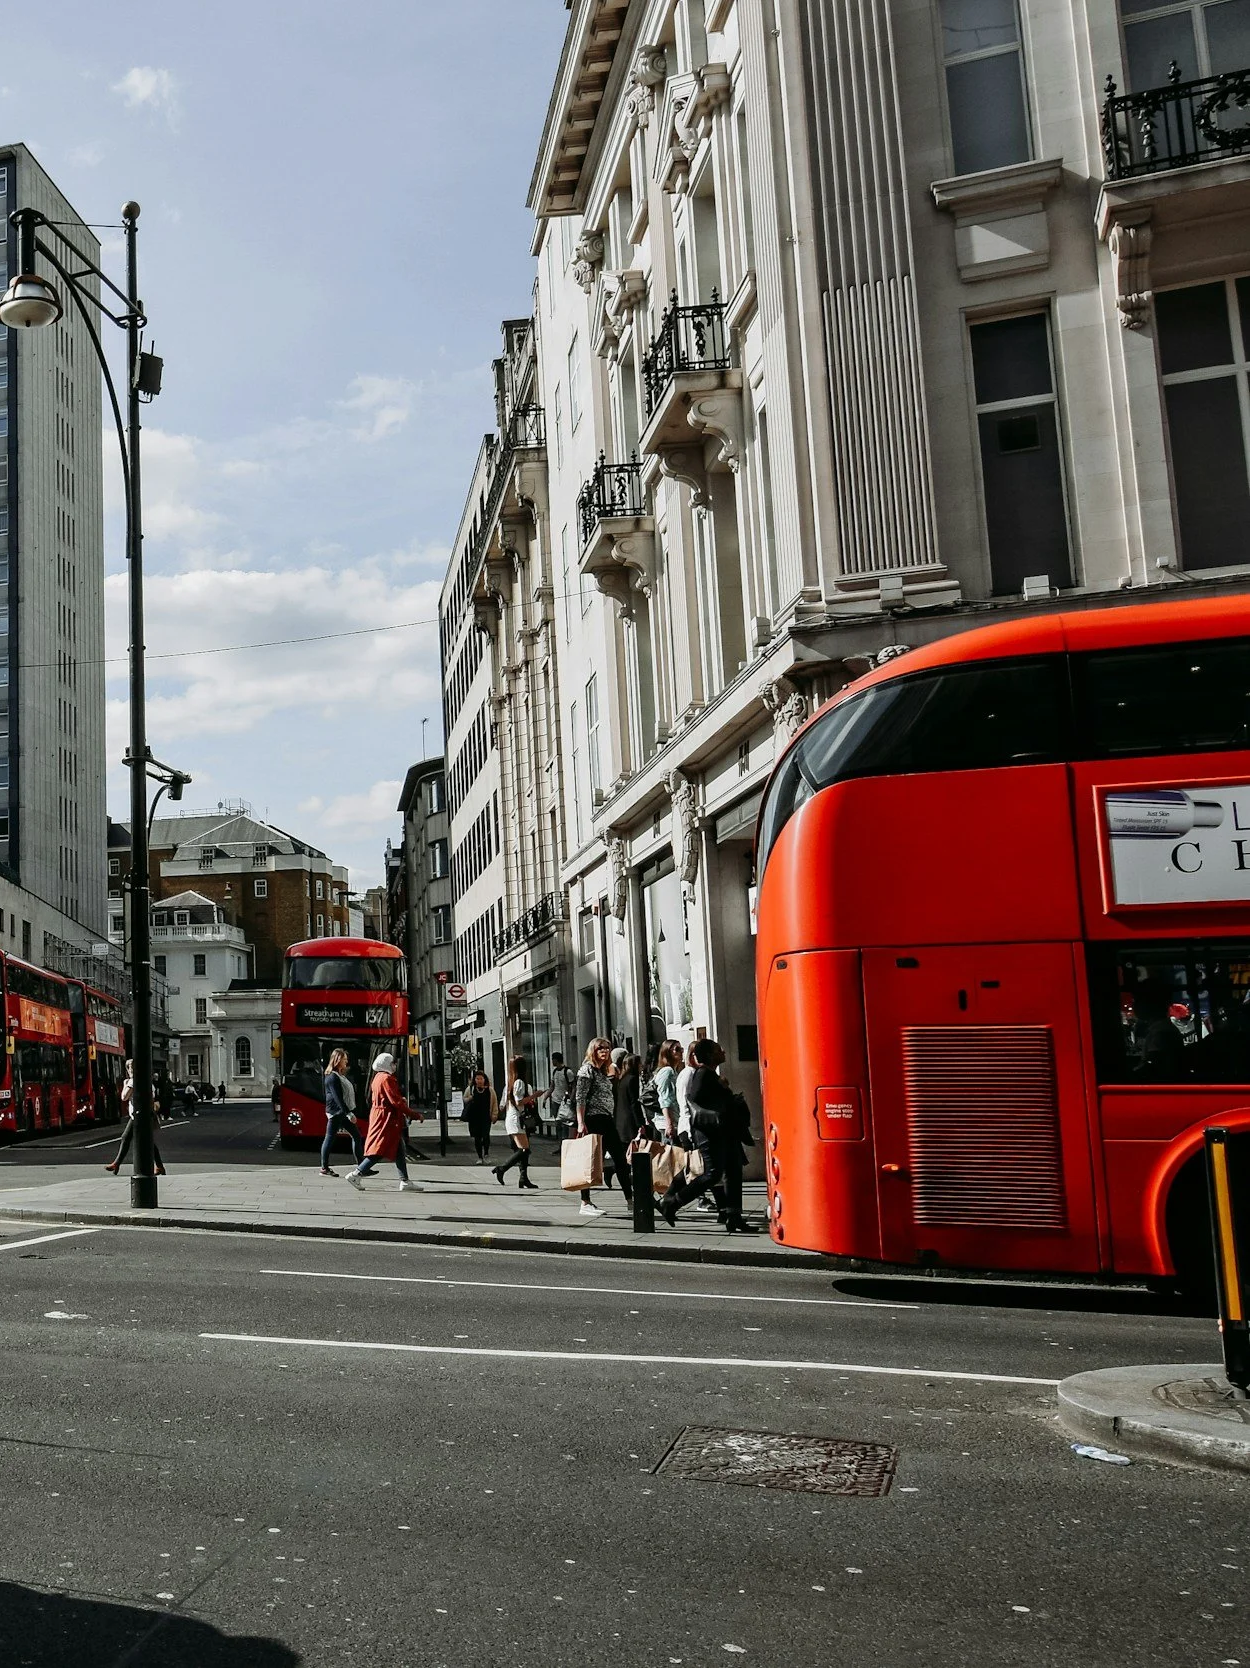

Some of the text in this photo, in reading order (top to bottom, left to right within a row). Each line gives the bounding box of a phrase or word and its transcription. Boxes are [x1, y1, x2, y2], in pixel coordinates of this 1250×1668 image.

[304, 1008, 384, 1023] Streatham Hill 137
